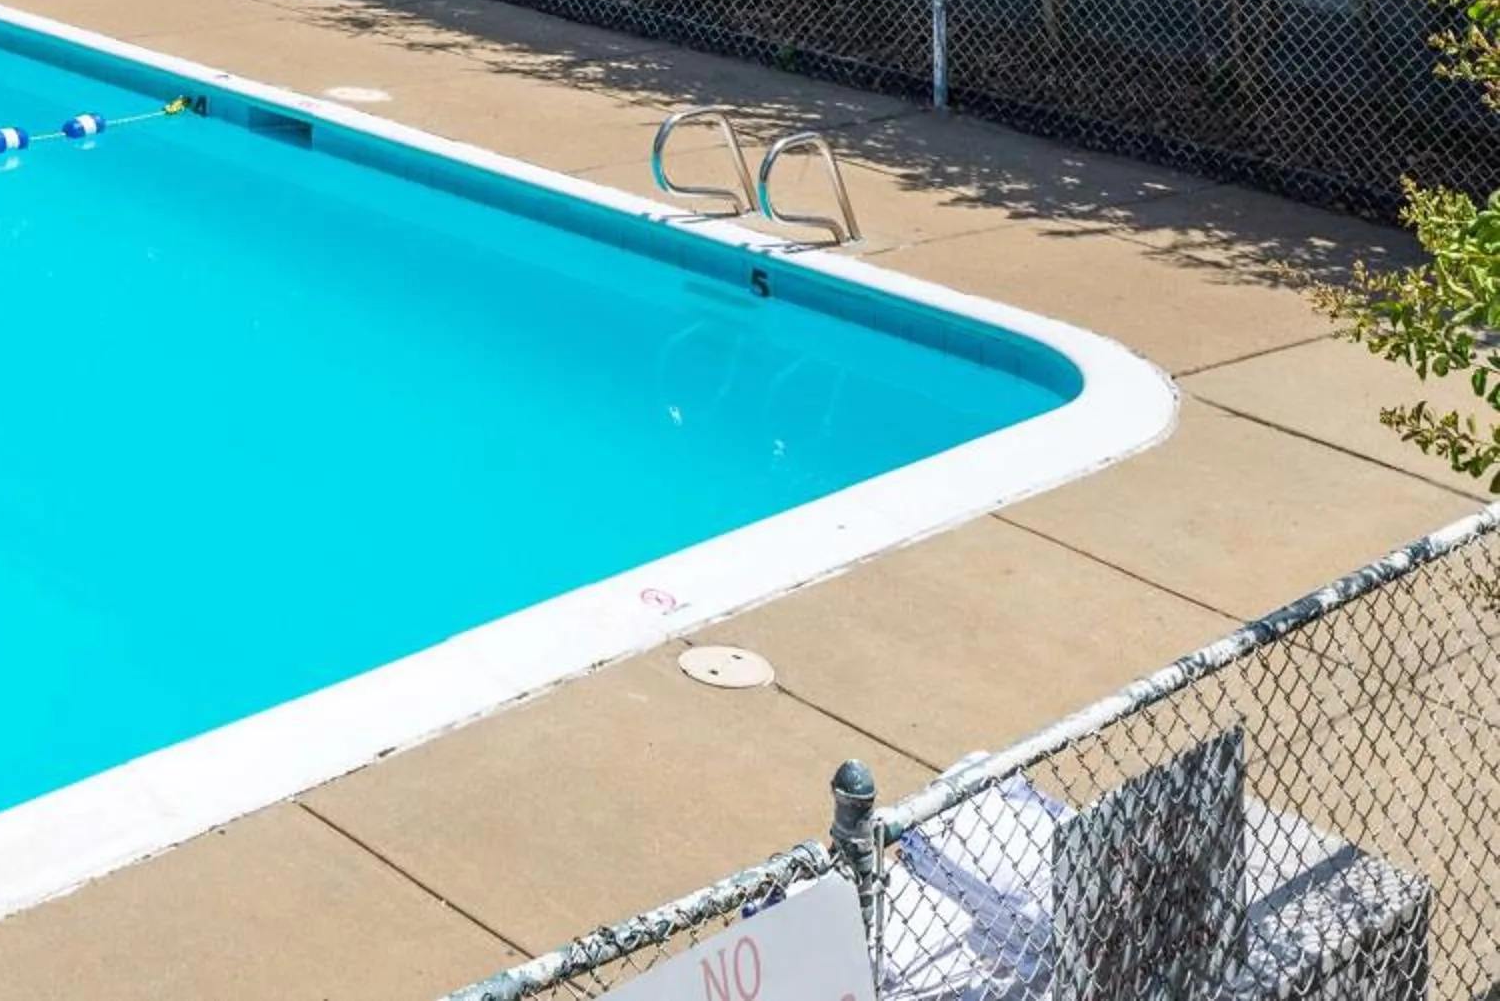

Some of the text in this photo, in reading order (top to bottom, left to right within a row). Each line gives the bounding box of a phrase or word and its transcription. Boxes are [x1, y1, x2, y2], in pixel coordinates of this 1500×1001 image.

[194, 95, 207, 117] 4
[751, 267, 769, 297] 5
[701, 935, 761, 1001] NO
